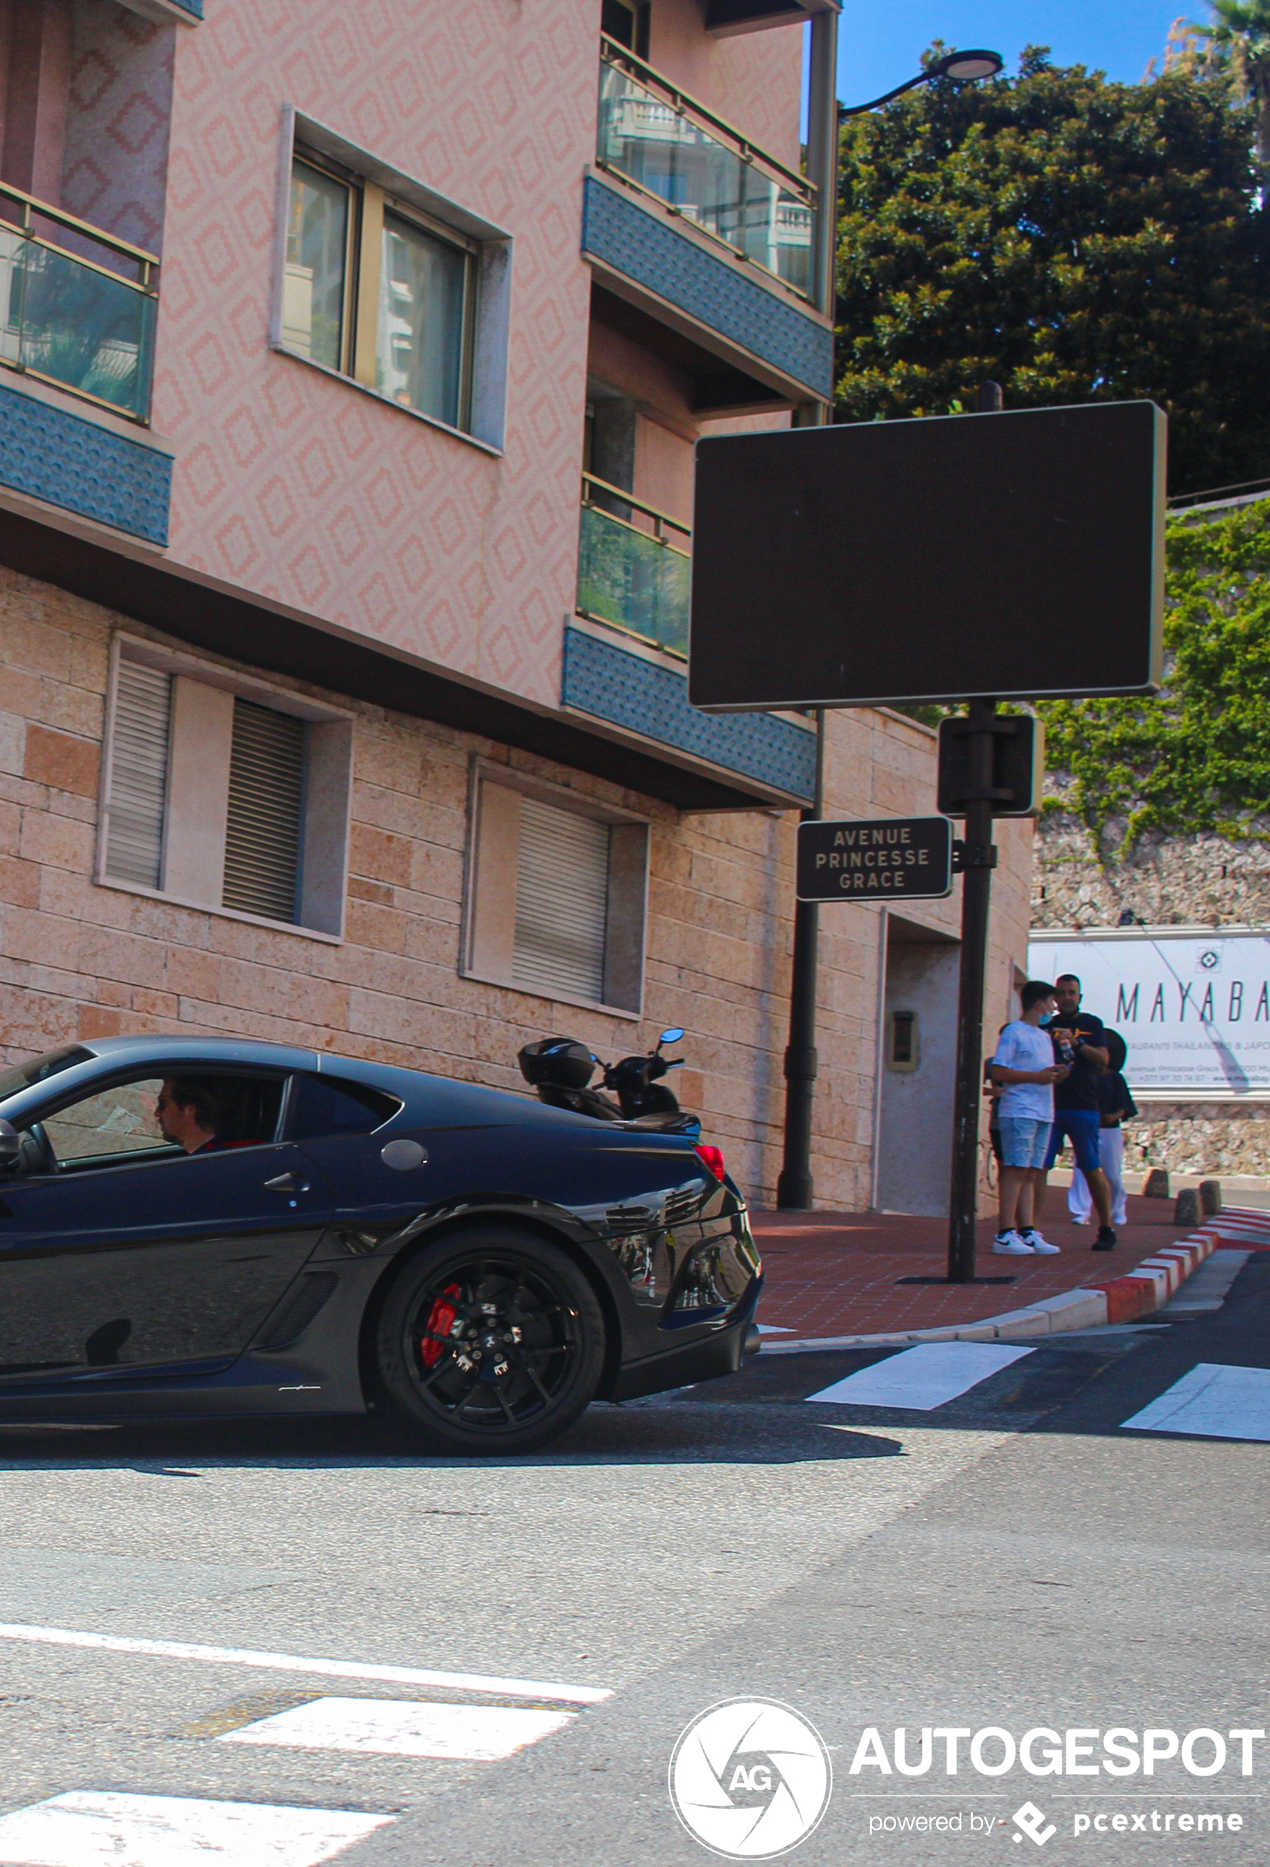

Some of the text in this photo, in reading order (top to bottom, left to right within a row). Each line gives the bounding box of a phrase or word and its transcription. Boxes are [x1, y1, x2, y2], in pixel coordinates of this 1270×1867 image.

[833, 827, 912, 847] AVENUE
[815, 848, 930, 869] PRINCESSE
[839, 871, 906, 889] GRACE
[1115, 980, 1270, 1023] MAYABA
